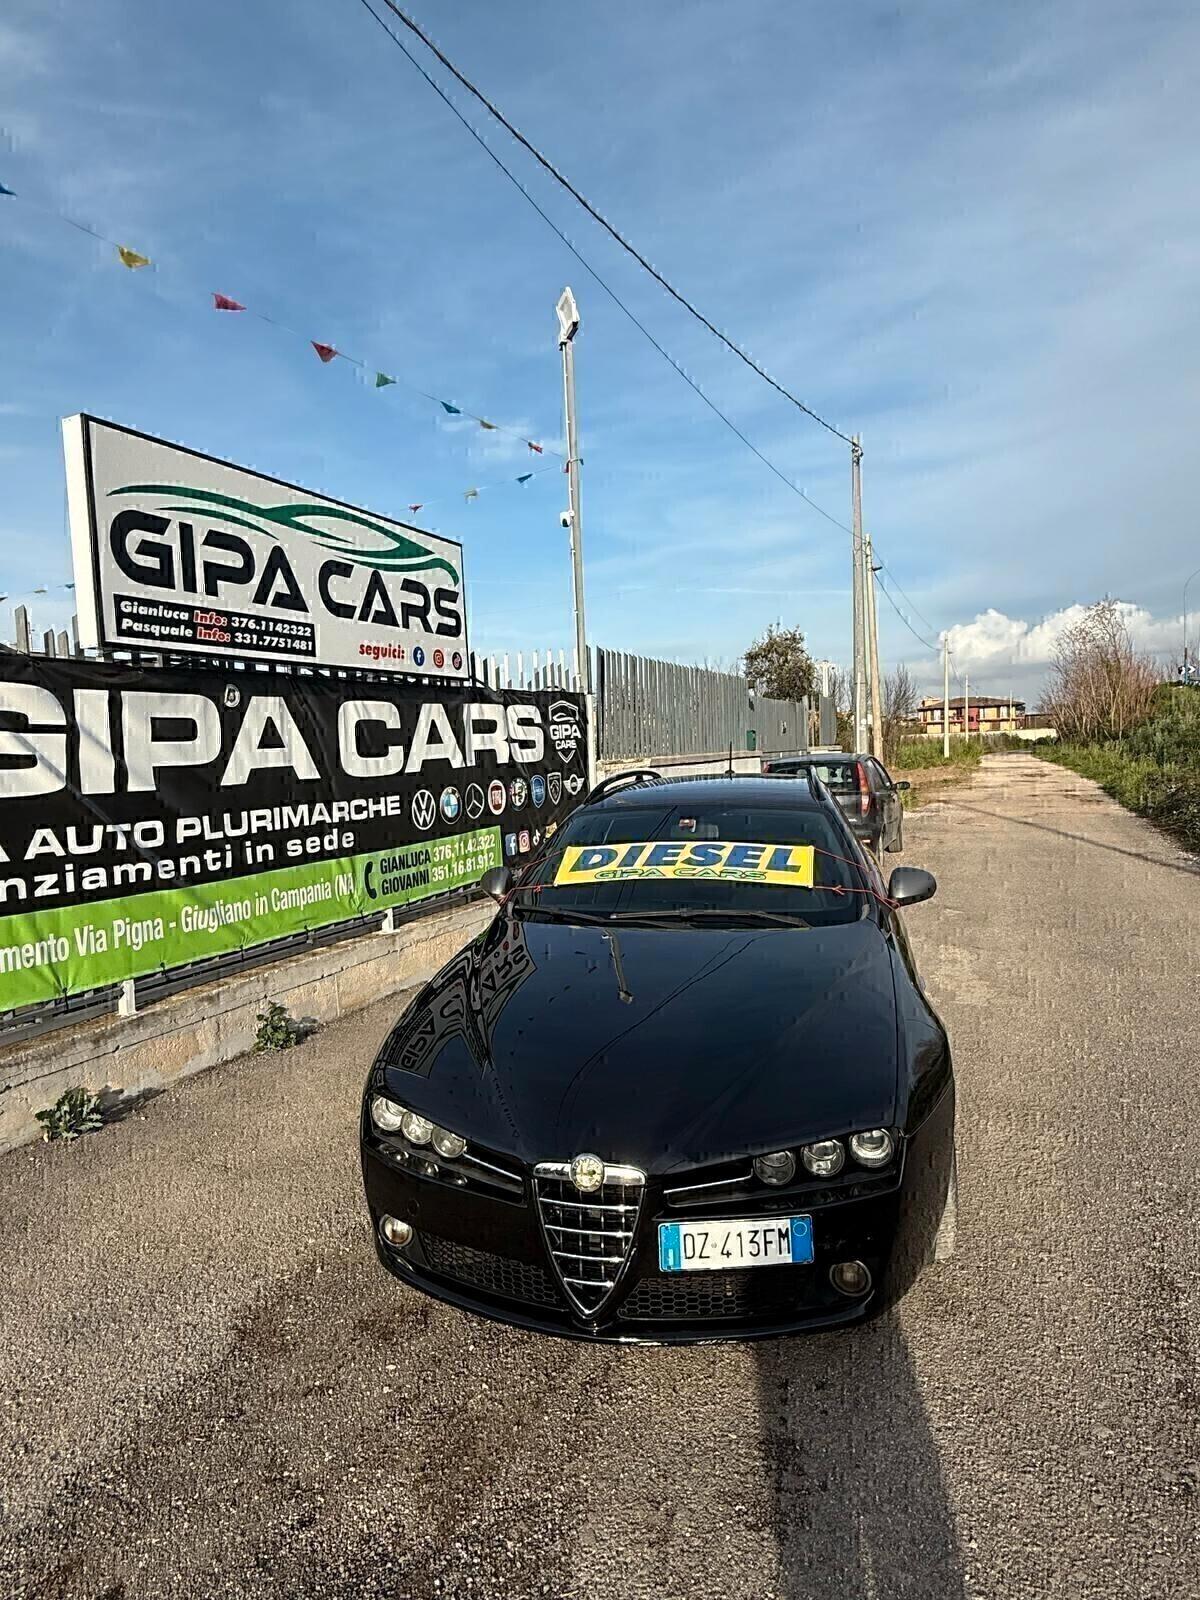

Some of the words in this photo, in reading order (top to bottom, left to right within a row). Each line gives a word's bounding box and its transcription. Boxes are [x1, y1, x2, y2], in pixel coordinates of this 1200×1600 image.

[110, 509, 309, 613] GIPA
[319, 559, 462, 638] CARS
[120, 601, 189, 620] Gianluca
[193, 611, 228, 626] Info:
[231, 617, 312, 637] 376.1142322
[121, 618, 193, 637] Pasquale
[196, 627, 231, 642] Info:
[234, 634, 313, 651] 331.7751481
[359, 643, 405, 660] seguici:
[338, 700, 544, 777] CARS
[550, 724, 581, 740] GIPA
[556, 739, 577, 750] CARS
[24, 820, 164, 860] AUTO
[176, 795, 401, 844] PLURIMARCHE
[245, 841, 274, 864] in
[286, 828, 354, 857] sede
[380, 849, 431, 875] GIANLUCA
[569, 844, 801, 872] DIESEL
[381, 868, 430, 896] GIOVANNI
[594, 867, 666, 880] GIPA
[672, 867, 767, 880] CARS
[74, 924, 107, 957] Via
[112, 917, 164, 951] Pigna
[181, 899, 251, 933] Giugliano
[255, 892, 268, 916] in
[271, 878, 331, 912] Campania
[683, 1232, 710, 1260] DZ
[720, 1227, 791, 1259] 413FM
